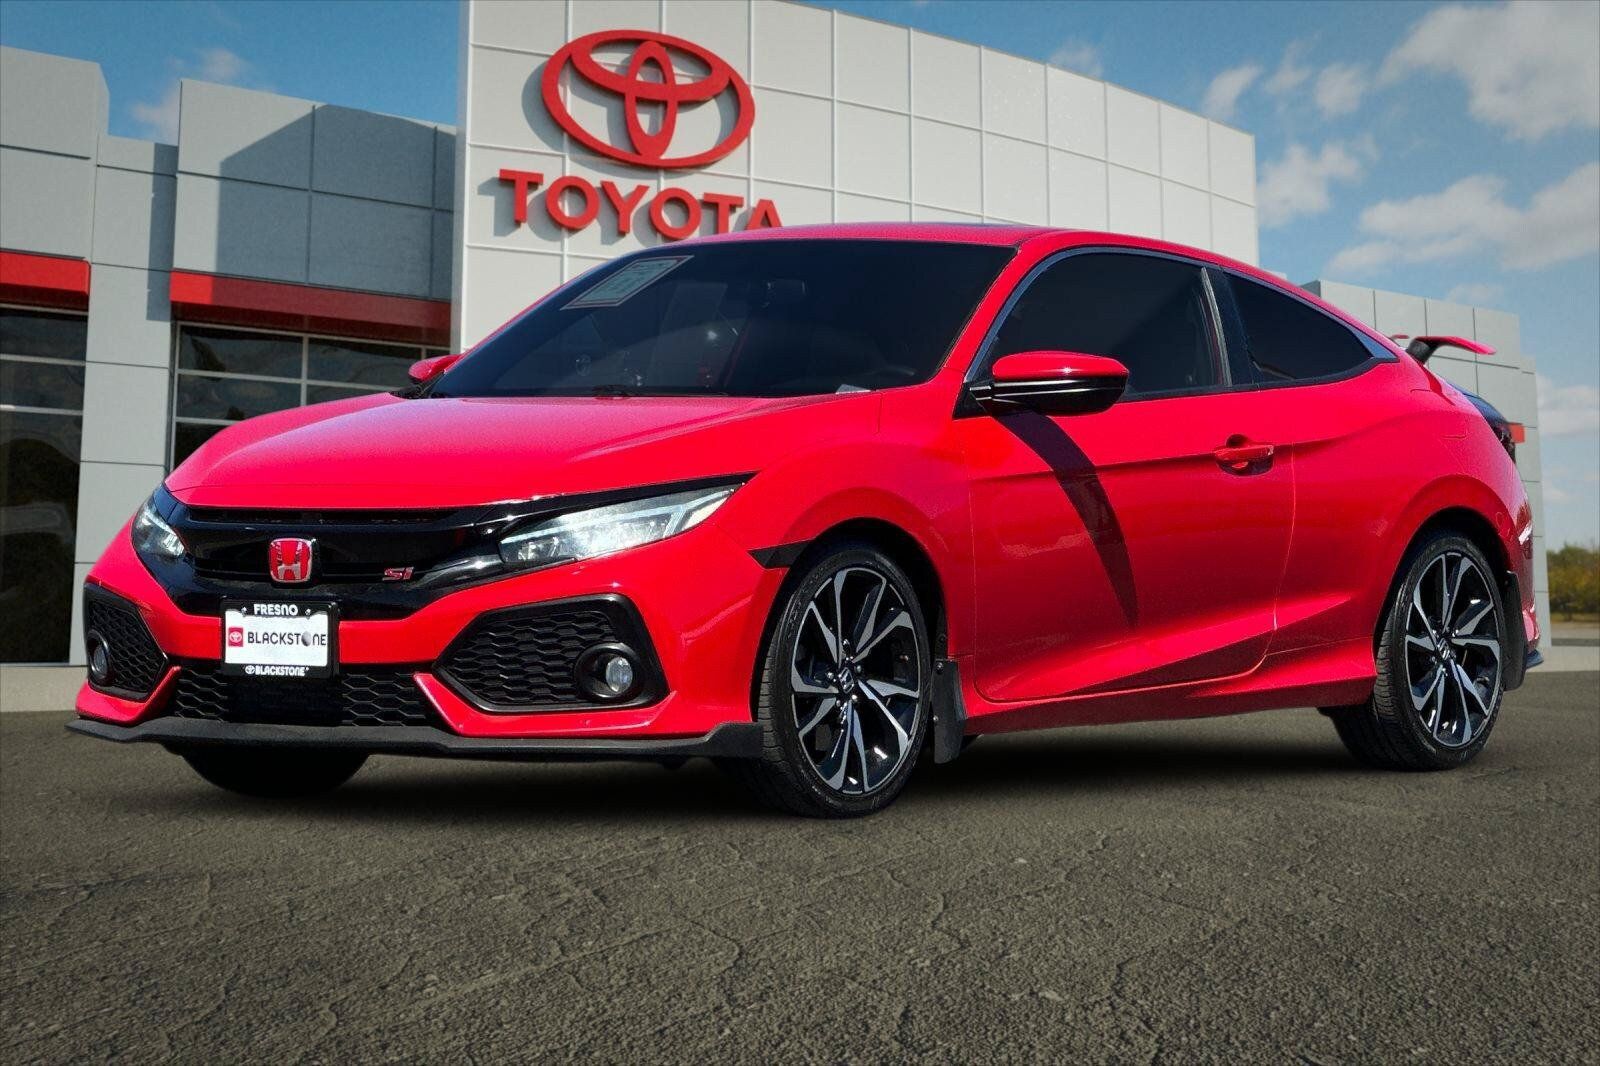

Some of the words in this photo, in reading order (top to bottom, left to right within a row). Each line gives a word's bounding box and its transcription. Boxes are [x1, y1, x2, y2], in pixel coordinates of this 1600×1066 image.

[499, 168, 783, 240] TOYOTA
[253, 603, 299, 616] FRESNO
[254, 665, 306, 677] BLACKSTONE
